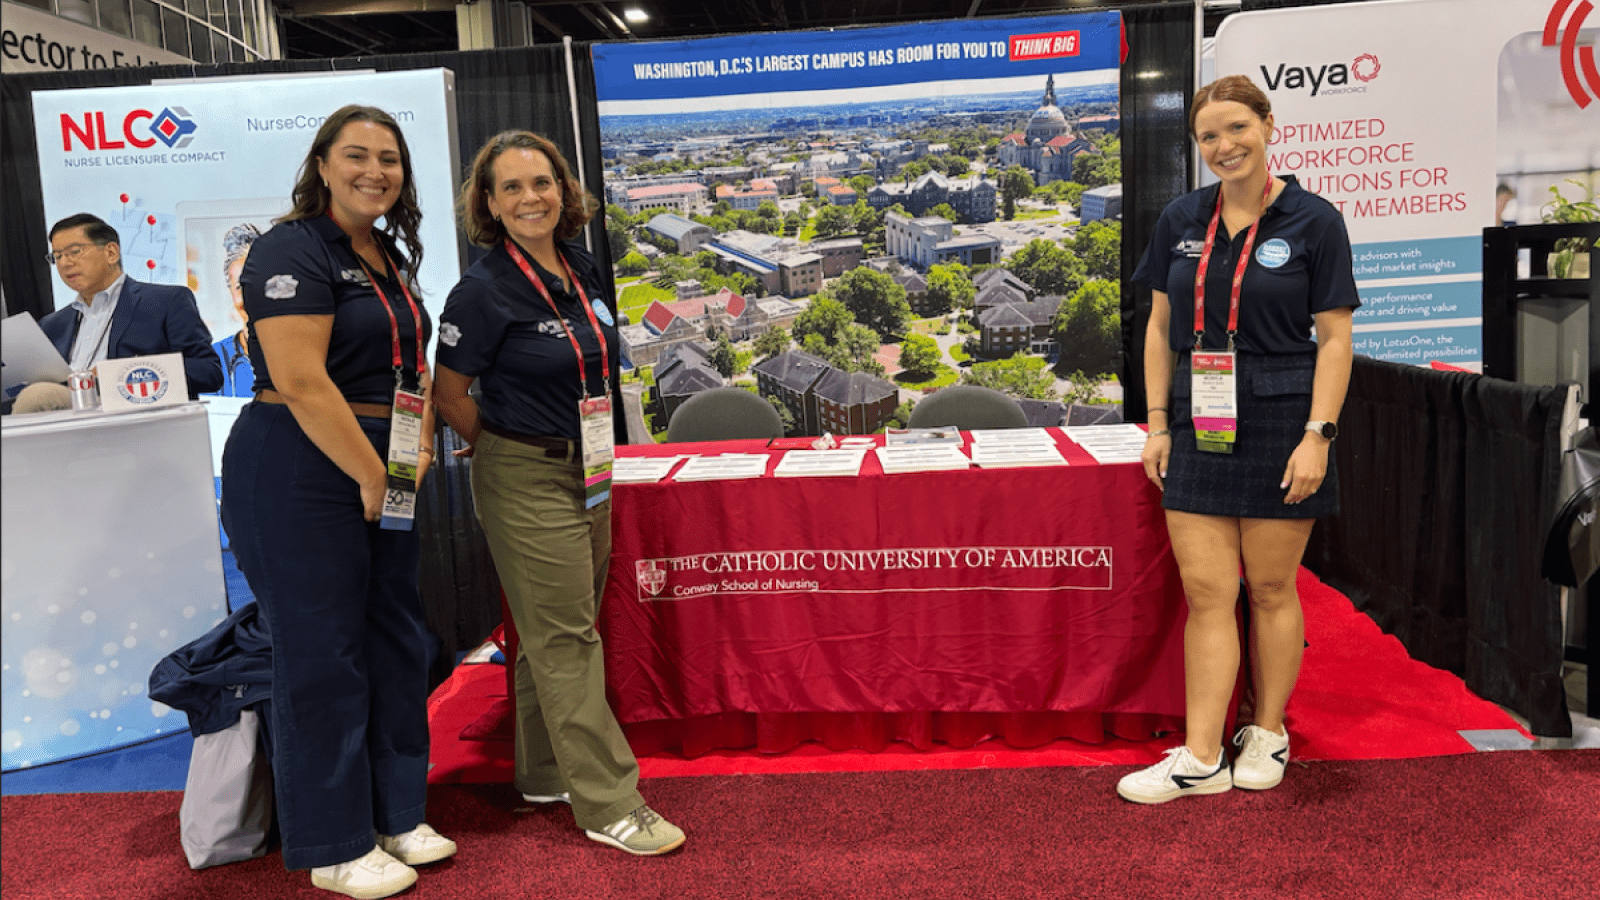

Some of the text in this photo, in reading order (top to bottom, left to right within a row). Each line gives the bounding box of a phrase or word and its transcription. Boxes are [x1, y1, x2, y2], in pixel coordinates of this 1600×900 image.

[633, 35, 1075, 80] WASHINGTON, D.C.'S LARGEST CAMPUS HAS ROOM FOR YOU TO THINK BIG
[1260, 63, 1348, 97] Vaya
[1320, 86, 1367, 96] WORKFORCE
[60, 108, 156, 151] NLC
[64, 151, 225, 167] NURSE LICENSURE COMPACT
[1266, 143, 1414, 171] WORKFORCE
[1299, 167, 1448, 195] UTIONS FOR
[1354, 192, 1466, 218] MEMBERS
[1360, 249, 1398, 261] advisors
[1401, 248, 1422, 259] with
[1382, 260, 1416, 273] market
[1419, 258, 1456, 273] insights
[1371, 292, 1433, 307] performance
[1377, 305, 1394, 315] and
[1397, 304, 1430, 317] driving
[1432, 302, 1457, 312] value
[1369, 338, 1381, 350] by
[1384, 335, 1434, 348] LotusOne,
[1437, 334, 1453, 344] the
[1376, 348, 1420, 360] unlimited
[1423, 345, 1477, 360] possibilities
[671, 549, 1112, 573] THE CATHOLIC UNIVERSITY OF AMERICA
[674, 578, 819, 596] Conway School of Nursing
